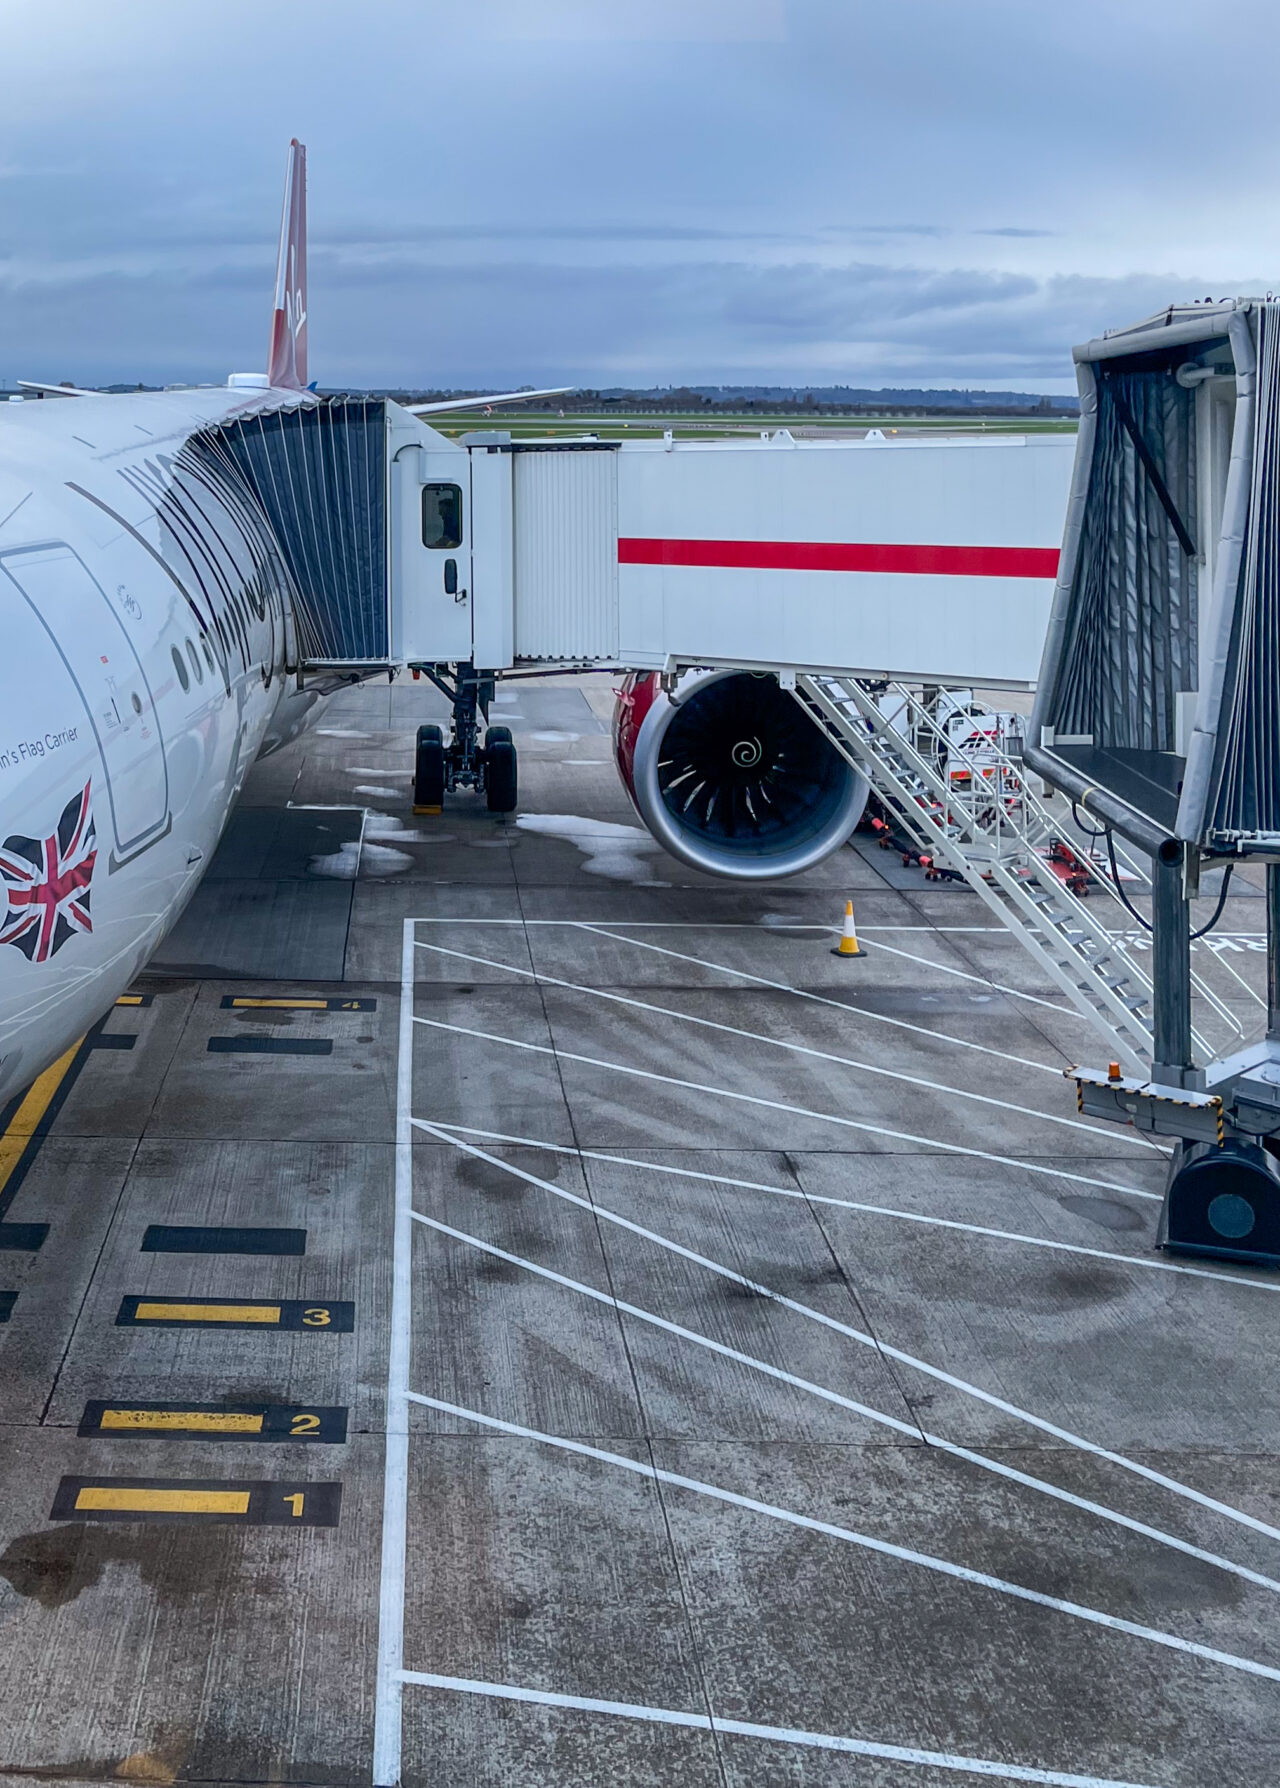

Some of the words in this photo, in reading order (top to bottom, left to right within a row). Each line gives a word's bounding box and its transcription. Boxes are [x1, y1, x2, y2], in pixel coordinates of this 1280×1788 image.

[18, 741, 45, 757] Flag
[44, 727, 78, 750] Carrier
[341, 1001, 360, 1009] 4
[302, 1308, 331, 1326] 3
[289, 1413, 321, 1435] 2
[283, 1493, 304, 1516] 1
